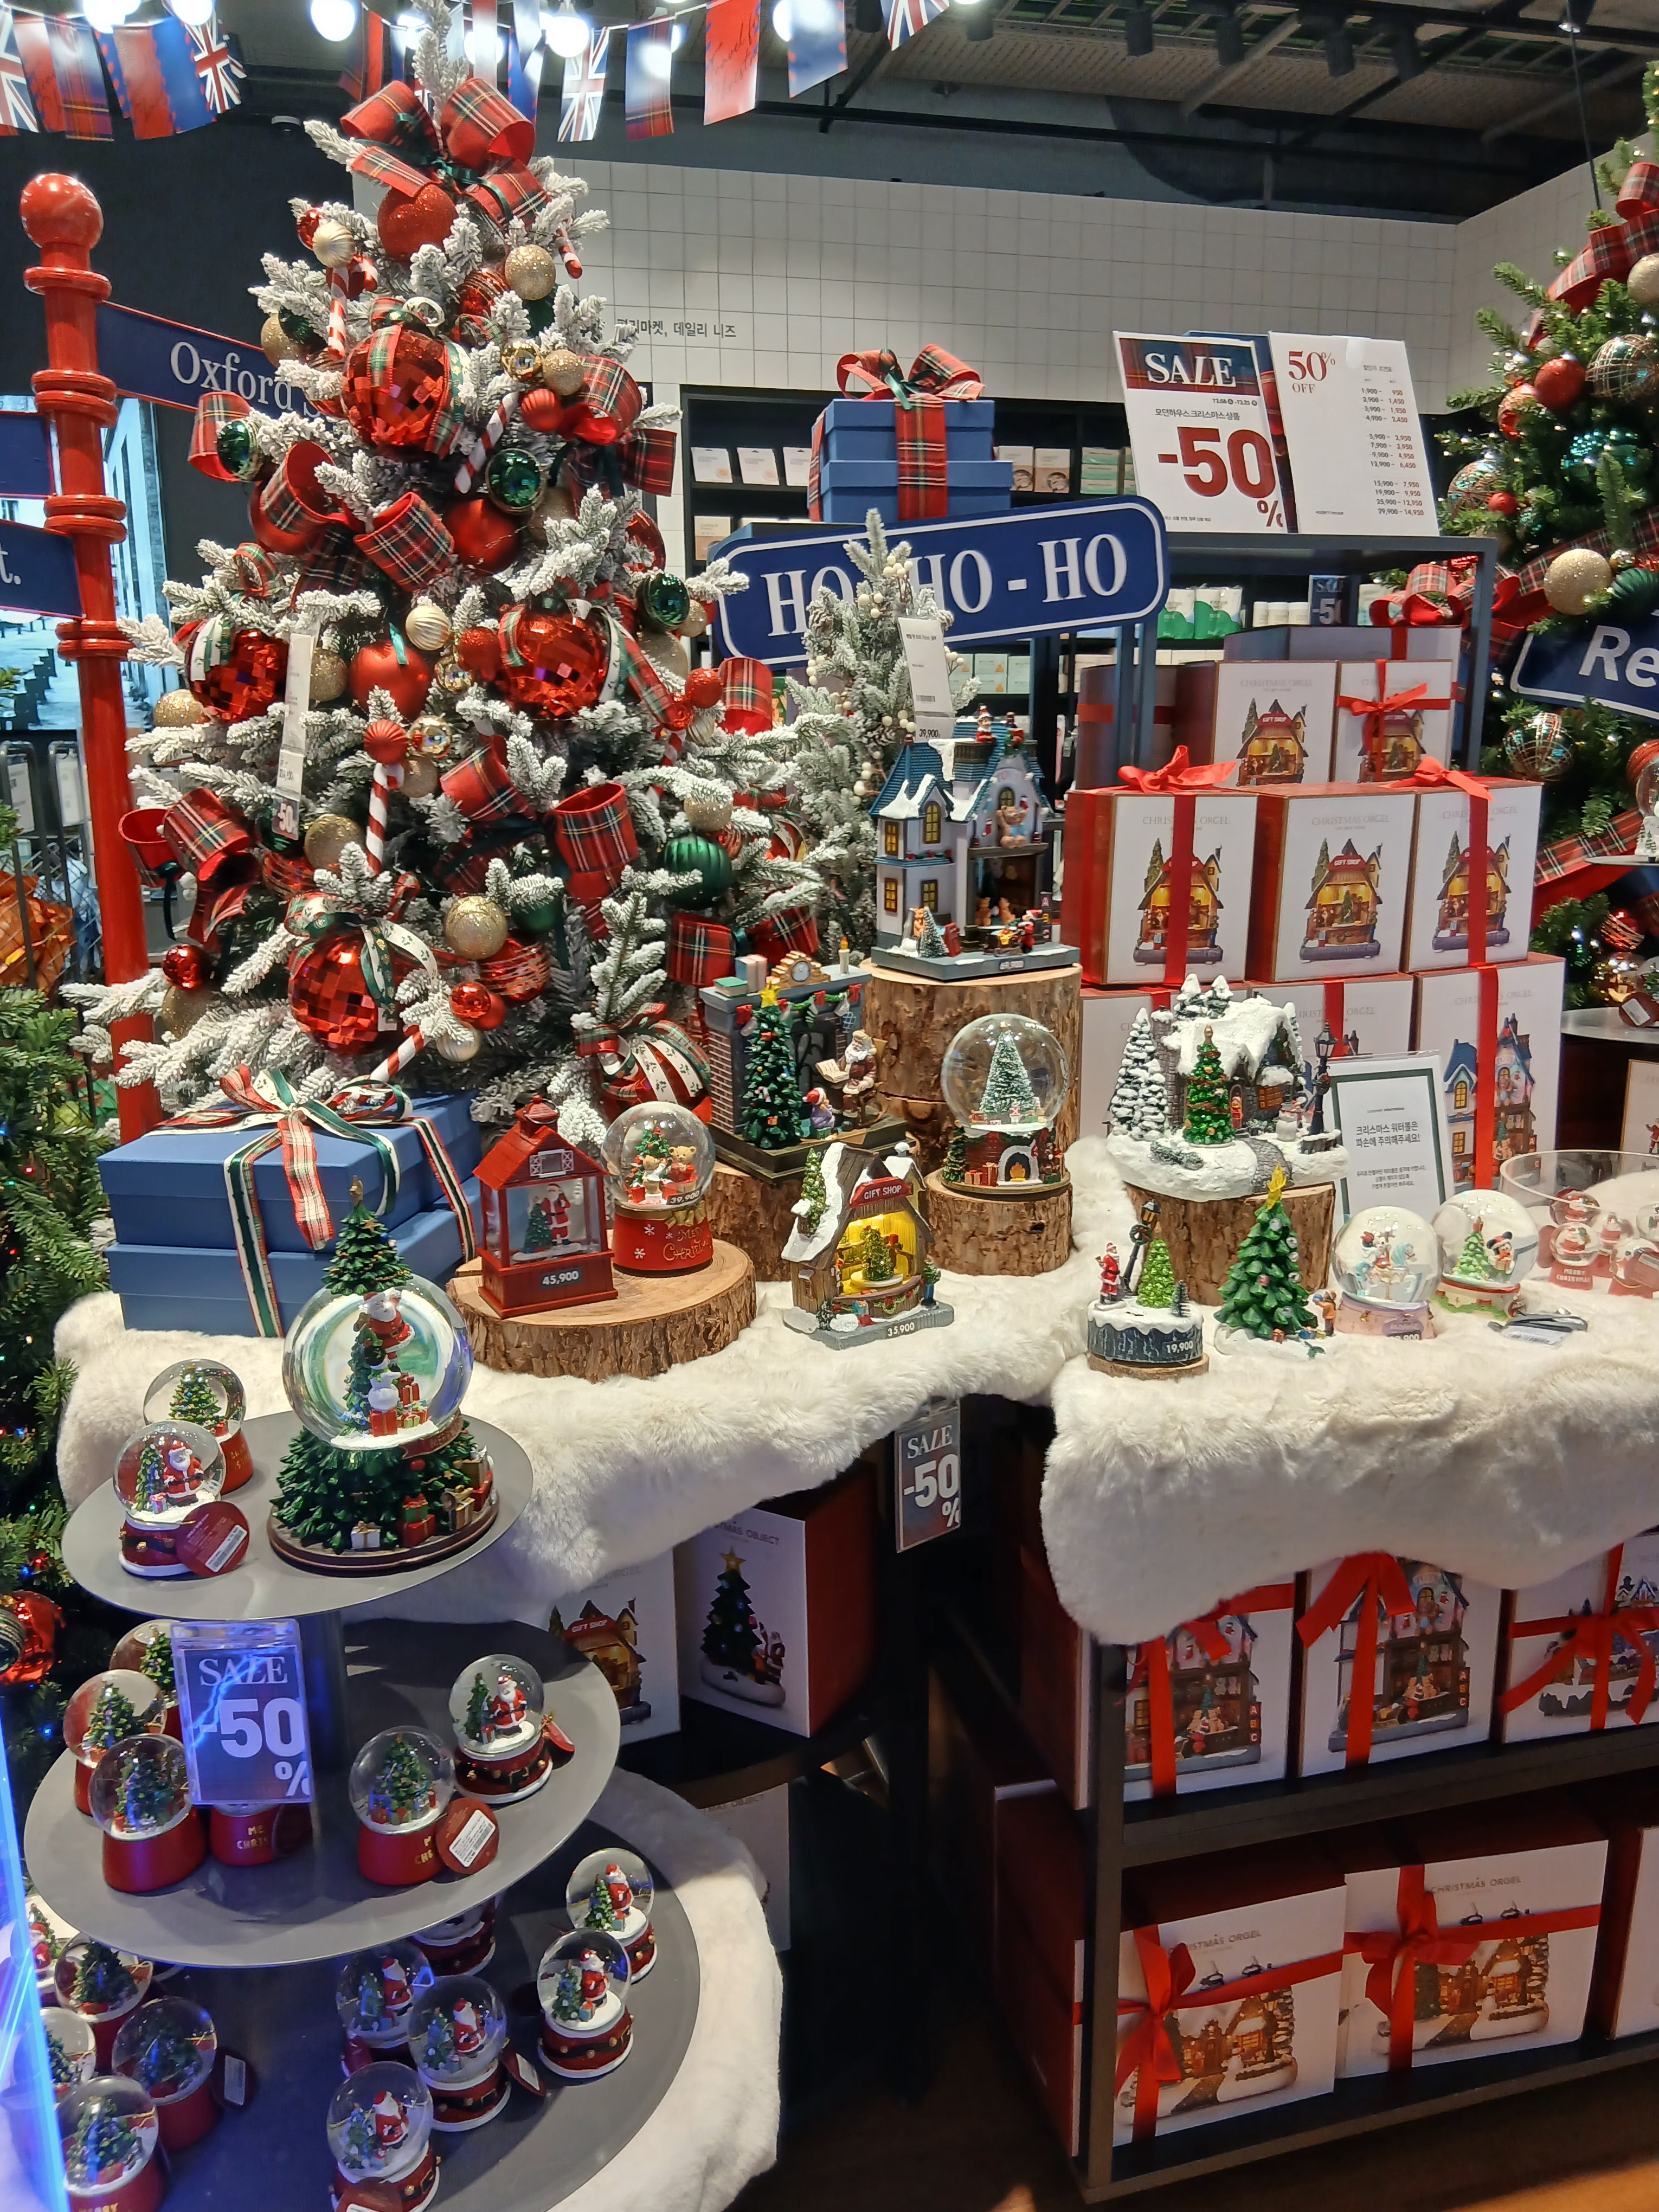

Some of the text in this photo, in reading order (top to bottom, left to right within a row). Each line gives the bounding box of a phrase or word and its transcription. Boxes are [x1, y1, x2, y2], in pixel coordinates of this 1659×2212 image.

[674, 322, 707, 337] 데일리
[713, 325, 736, 338] 니즈
[1144, 352, 1237, 388] SALE
[1292, 383, 1315, 394] OFF
[1158, 426, 1276, 498] -50
[760, 565, 853, 638] HO
[909, 550, 993, 618] HO
[1038, 533, 1127, 603] HO
[1579, 625, 1659, 688] Re
[1200, 816, 1230, 825] ORGEL
[1311, 815, 1361, 825] CHRISTMAS
[1346, 1007, 1376, 1015] ORGEL
[1356, 1124, 1390, 1135] 크리스마스
[1356, 1137, 1376, 1148] 파손에
[670, 1191, 699, 1204] 39,900
[864, 1185, 902, 1200] GIFT SHOP
[542, 1270, 579, 1285] 45,900
[887, 1322, 915, 1337] 35,900
[1166, 1340, 1193, 1354] 19,900
[907, 1425, 953, 1459] SALE
[904, 1454, 959, 1507] -50
[198, 1656, 288, 1687] SALE
[200, 1697, 305, 1758] -50
[1489, 1875, 1522, 1887] ORGEL
[1228, 1930, 1262, 1943] ORGEL
